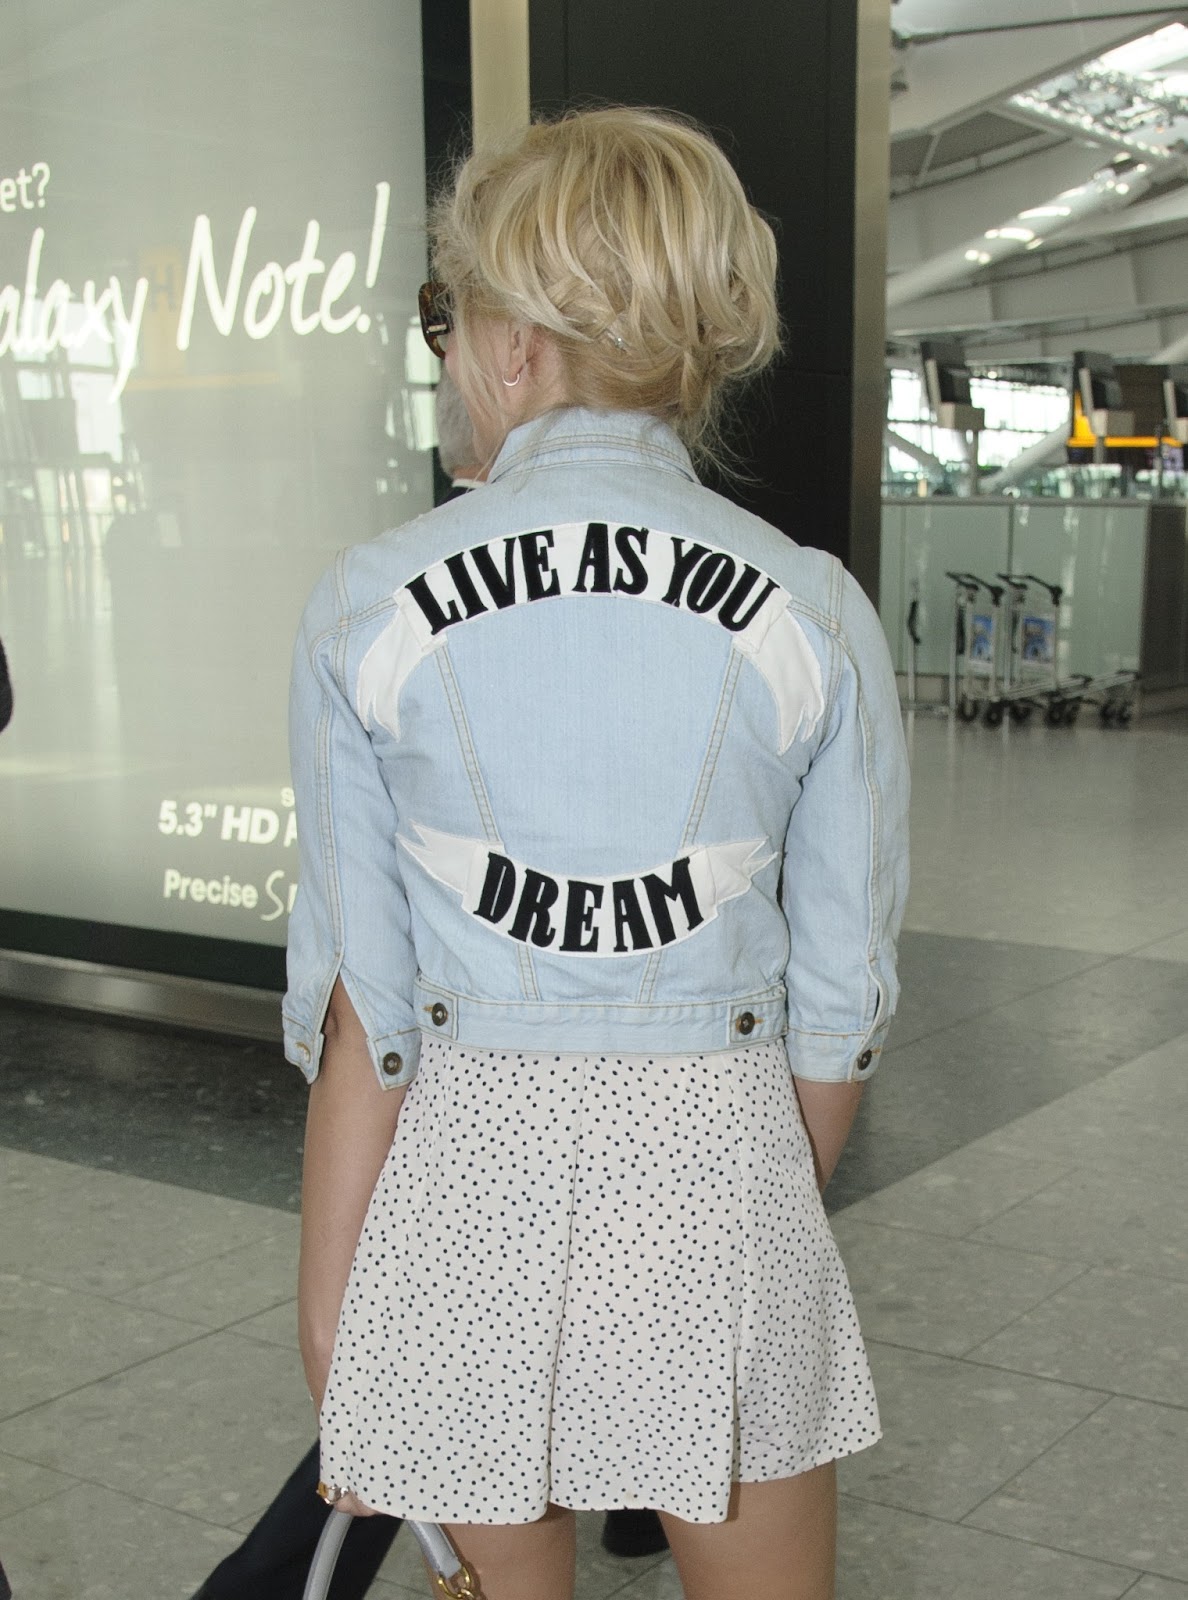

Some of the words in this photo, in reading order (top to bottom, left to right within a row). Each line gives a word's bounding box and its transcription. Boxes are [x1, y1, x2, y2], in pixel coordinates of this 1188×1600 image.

[0, 162, 51, 212] et?
[177, 181, 391, 351] Note!
[404, 528, 562, 636] LIVE
[571, 522, 650, 596] AS
[661, 536, 780, 633] YOU
[158, 799, 218, 837] 5.3"
[220, 804, 280, 845] HD
[163, 868, 259, 909] Precise
[472, 851, 705, 953] DREAM
